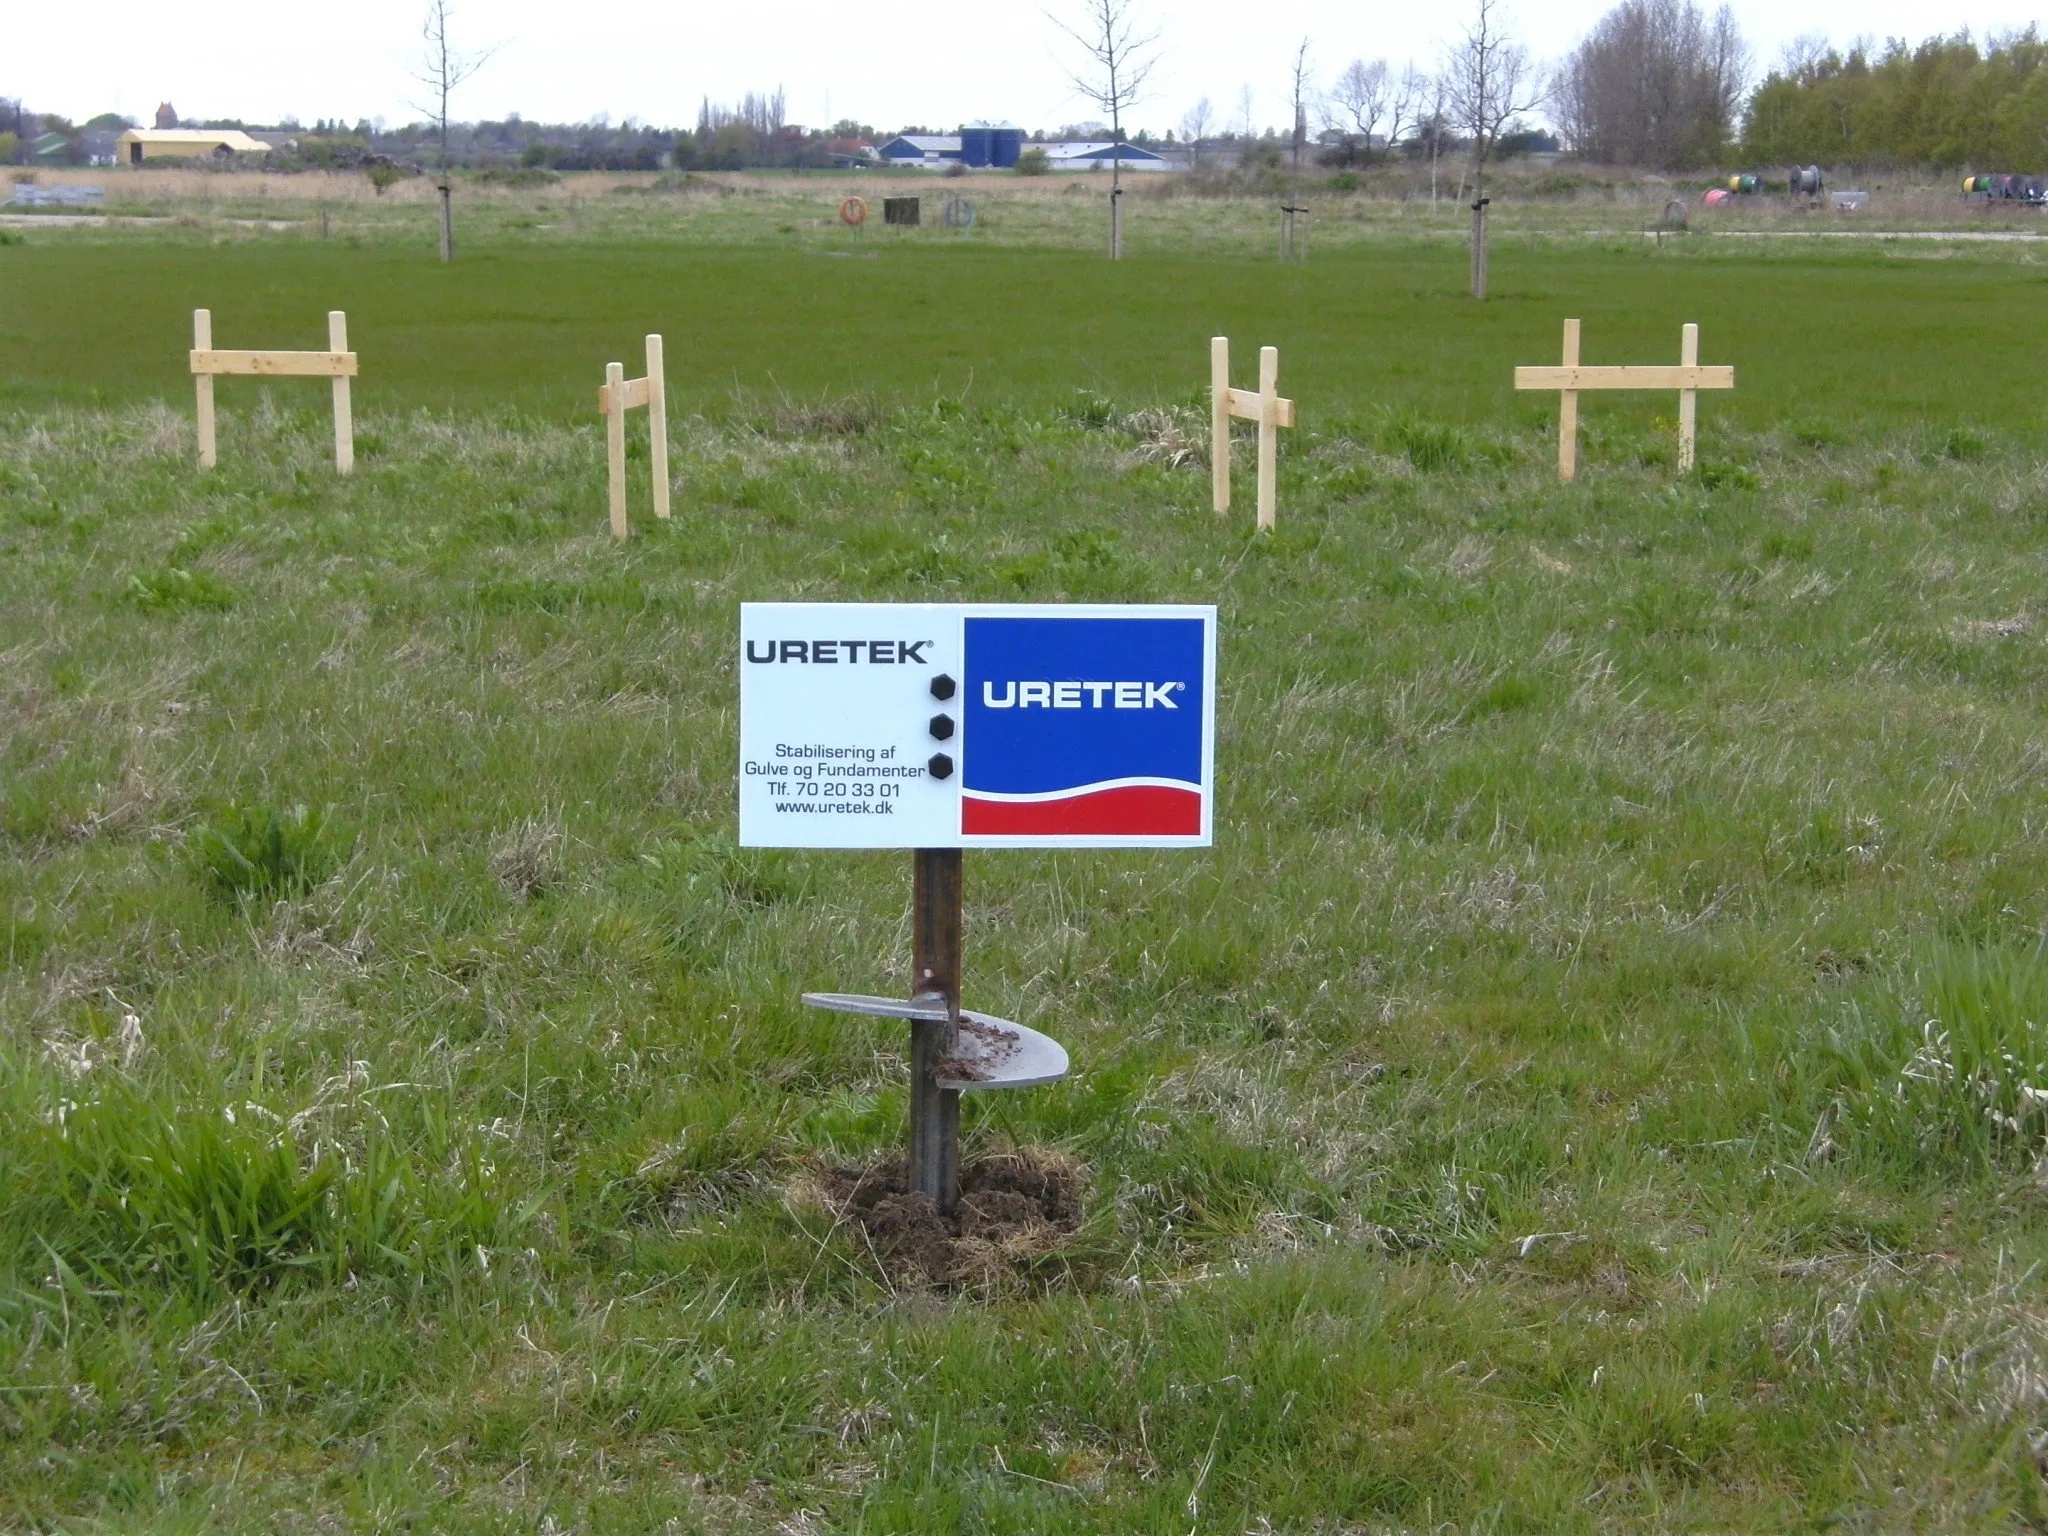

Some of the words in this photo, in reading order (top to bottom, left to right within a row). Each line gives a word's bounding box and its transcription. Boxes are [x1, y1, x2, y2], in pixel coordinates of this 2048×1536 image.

[775, 743, 875, 762] Stabilisering
[880, 745, 896, 759] af
[745, 761, 788, 776] Gulve
[793, 764, 812, 779] og
[818, 762, 926, 777] Fundamenter
[767, 782, 790, 796] Tlf.
[796, 782, 818, 796] 70
[823, 783, 846, 797] 20
[851, 783, 874, 797] 33
[880, 783, 900, 797] 01
[775, 800, 893, 814] www.uretek.dk
